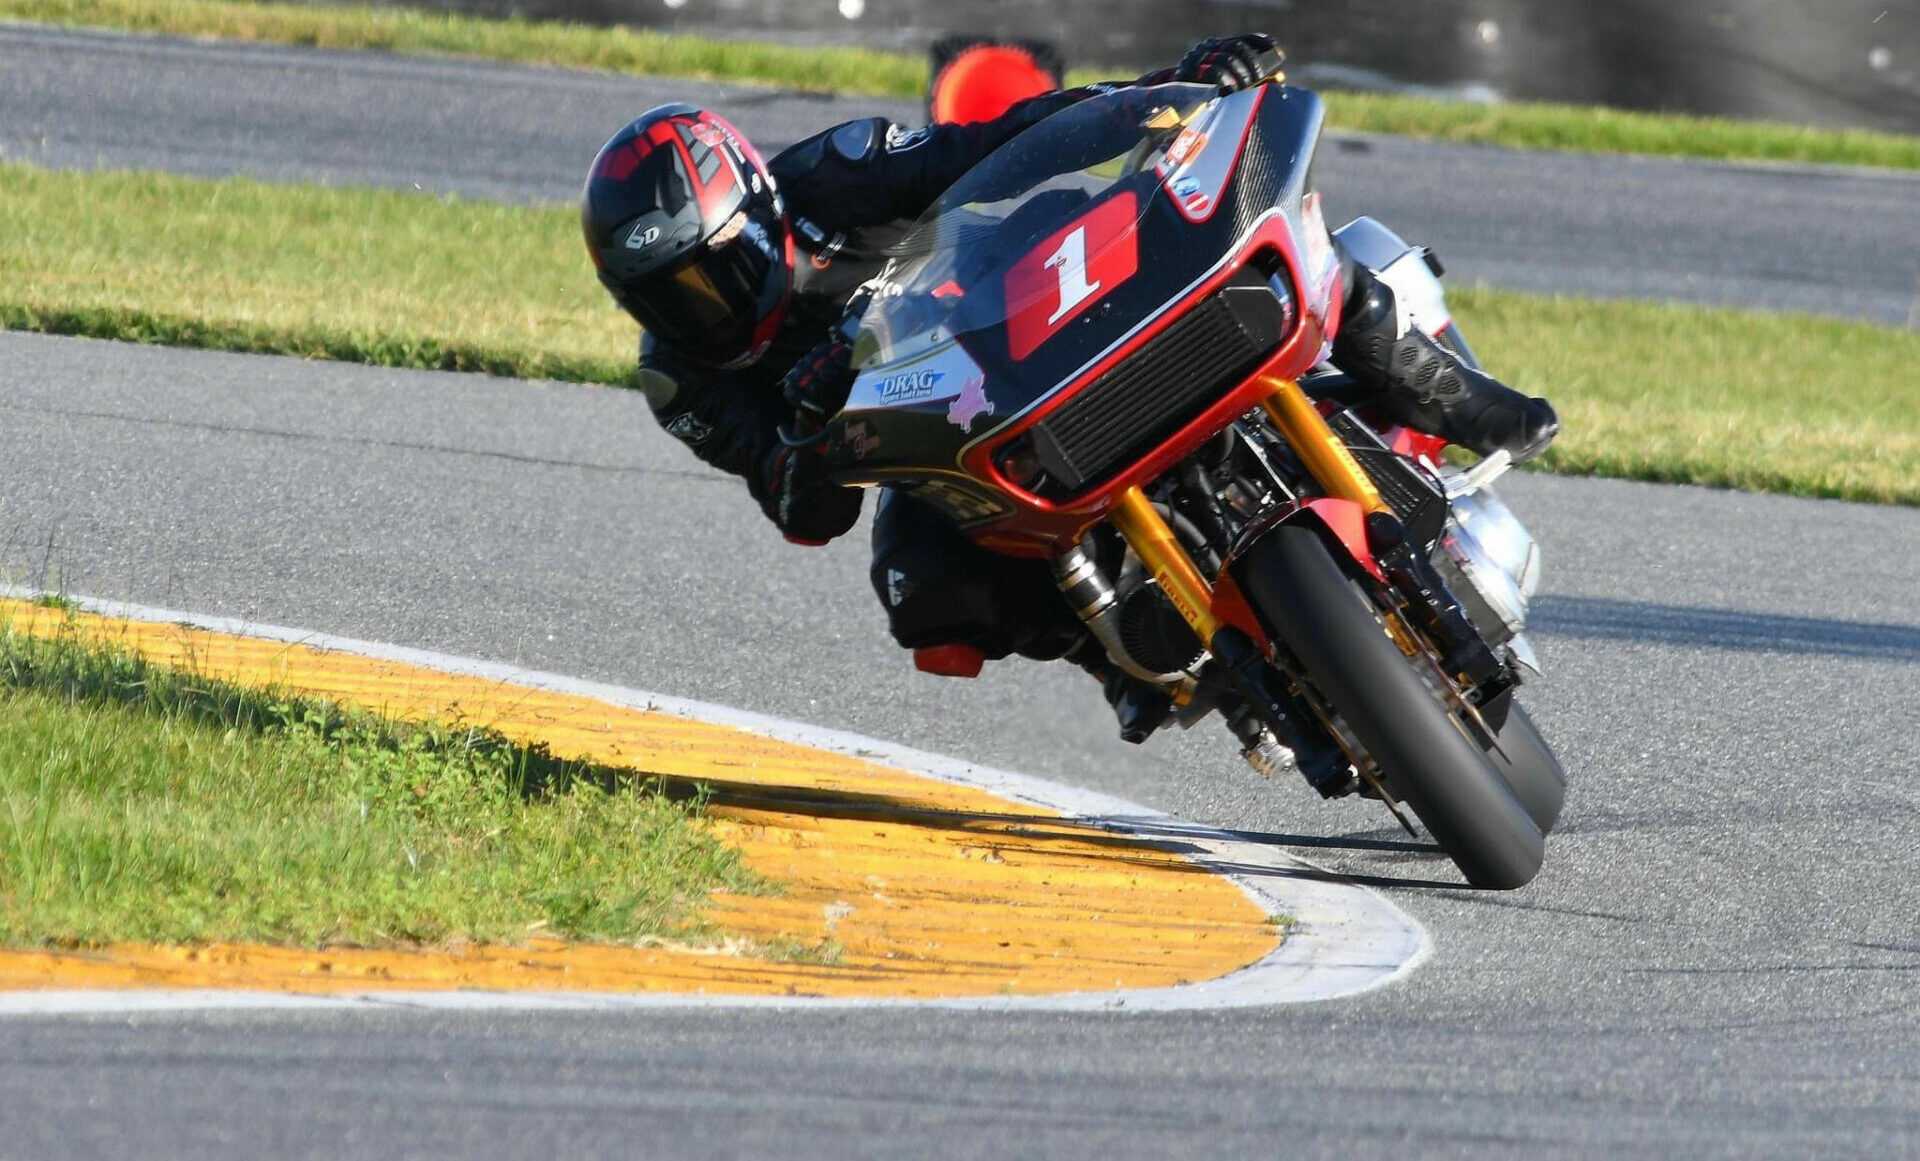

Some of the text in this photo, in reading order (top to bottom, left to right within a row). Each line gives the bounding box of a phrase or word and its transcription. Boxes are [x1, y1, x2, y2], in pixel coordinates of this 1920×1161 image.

[625, 223, 660, 249] 6D
[1044, 225, 1101, 326] 1
[882, 370, 933, 395] DRAG
